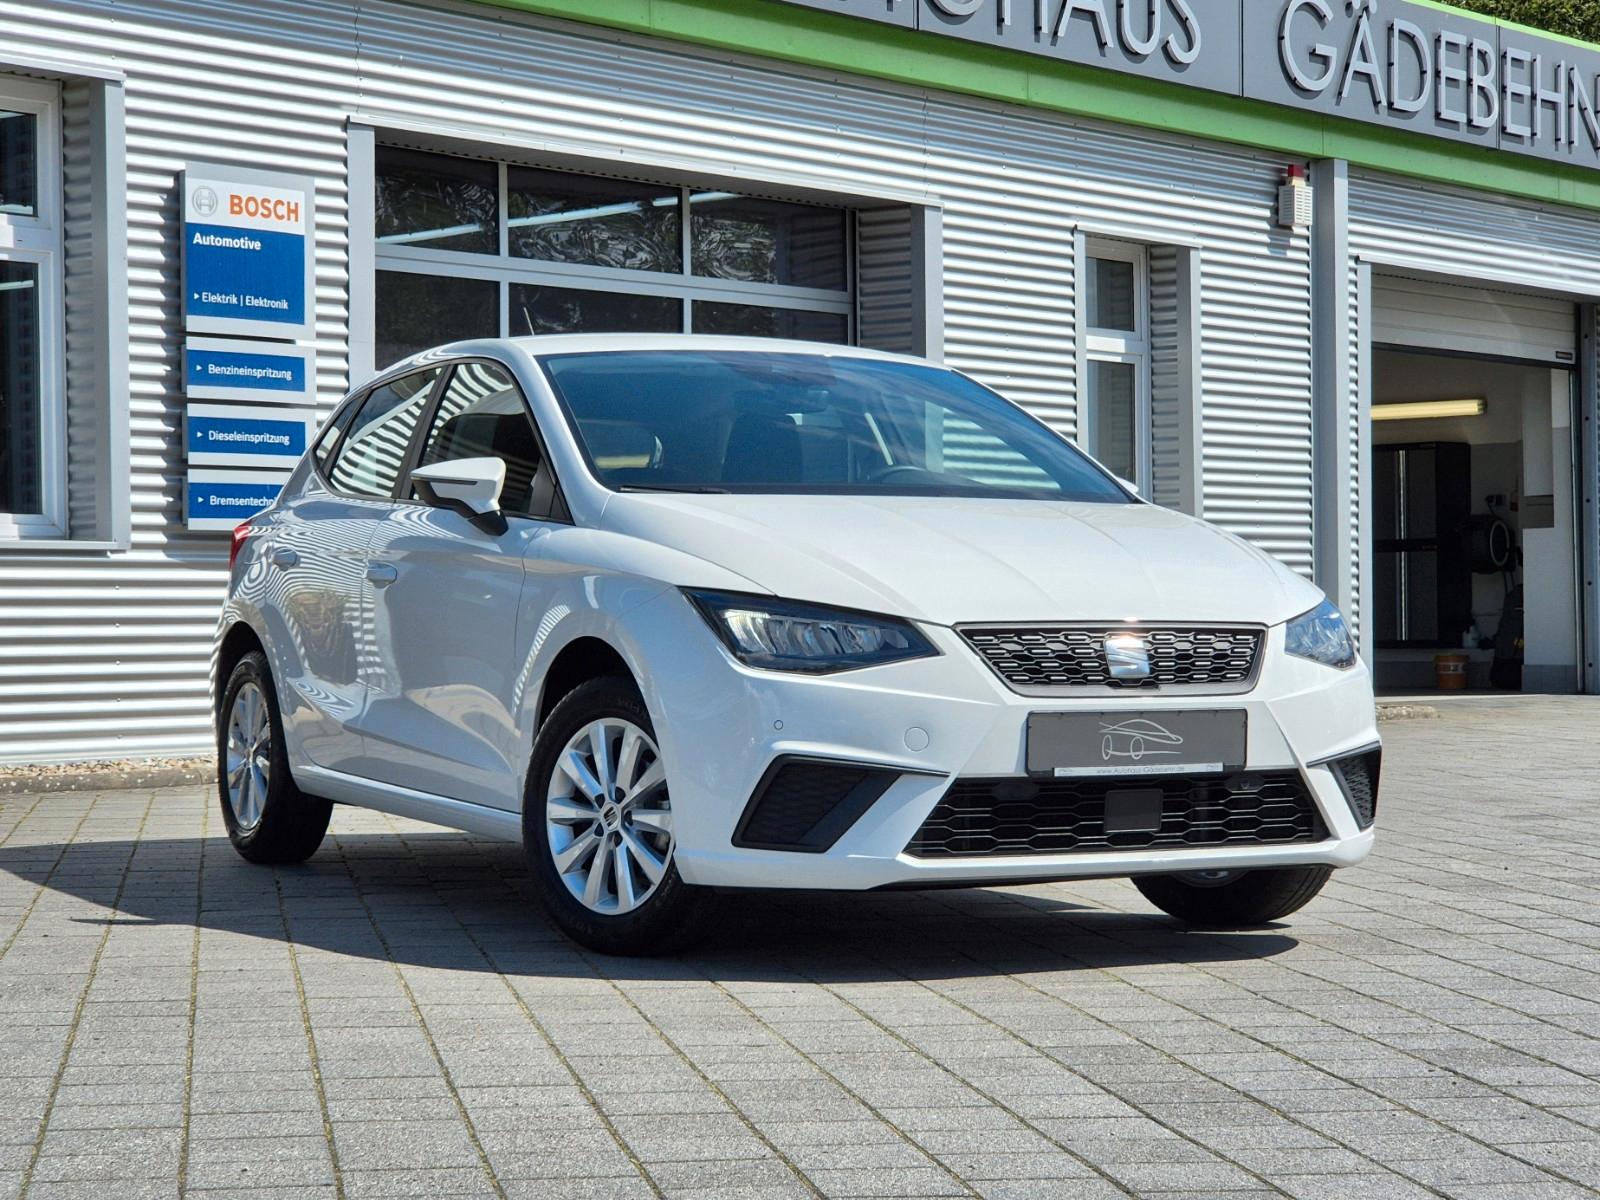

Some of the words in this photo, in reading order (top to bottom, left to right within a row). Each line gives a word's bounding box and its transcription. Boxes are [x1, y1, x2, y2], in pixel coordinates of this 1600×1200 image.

[1283, 0, 1600, 150] GÄDEBEHN
[230, 195, 299, 222] BOSCH
[193, 233, 261, 250] Automotive
[202, 292, 238, 305] Elektrik
[246, 296, 288, 310] Elektronik
[208, 364, 292, 380] Benzineinspritzung
[208, 431, 290, 445] Dieseleinspritzung
